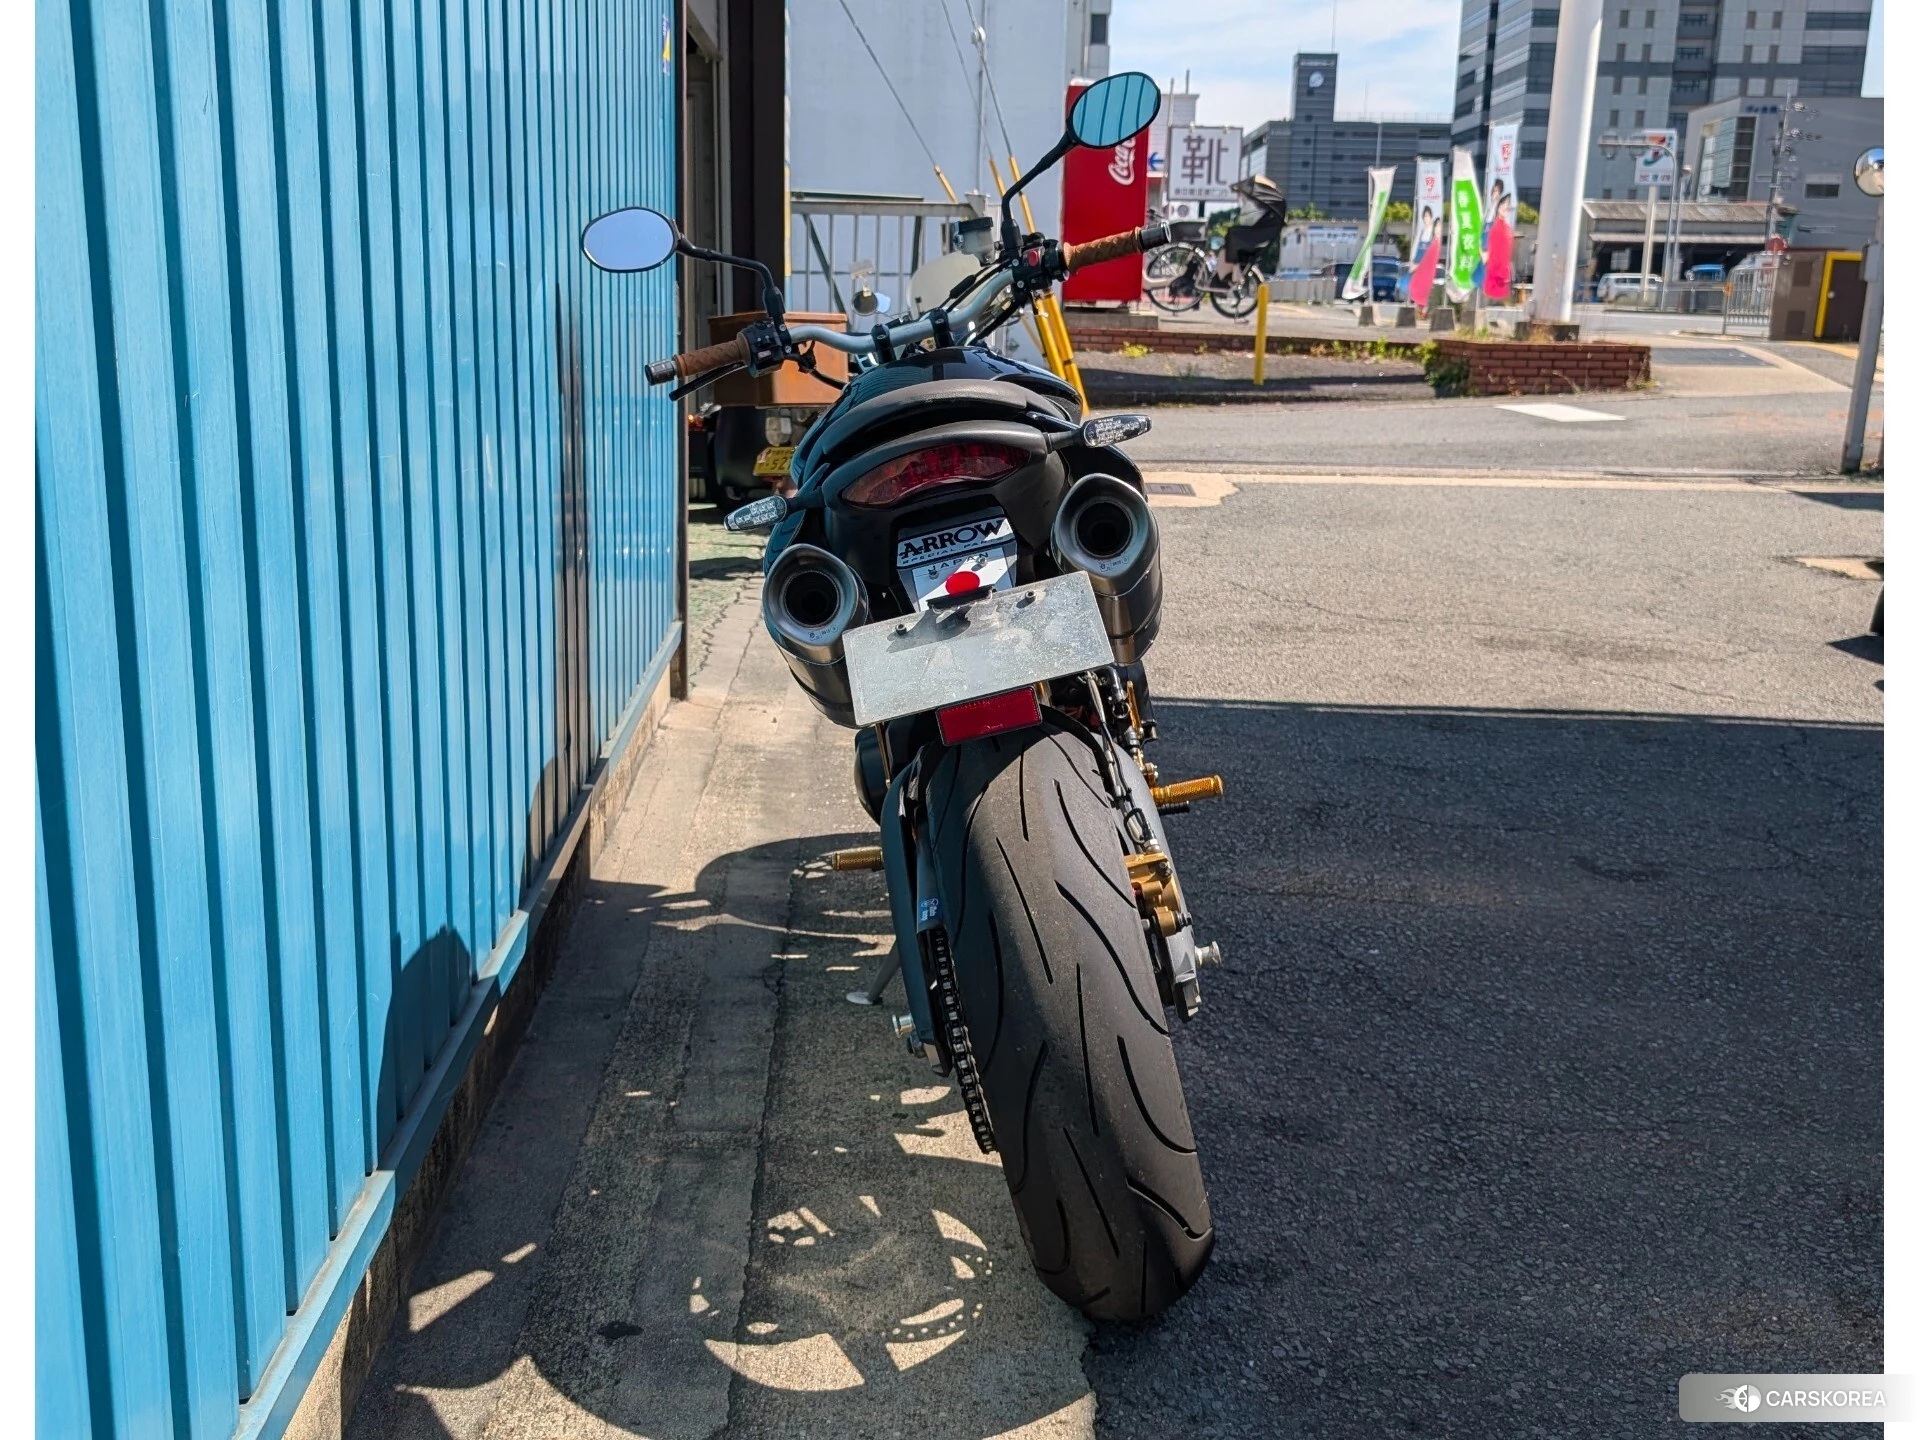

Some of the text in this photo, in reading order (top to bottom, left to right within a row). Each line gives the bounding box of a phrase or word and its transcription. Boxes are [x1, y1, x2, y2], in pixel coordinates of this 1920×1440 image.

[1181, 135, 1229, 185] 靴
[899, 519, 1004, 560] ARROW
[902, 548, 957, 565] SPECIAL
[928, 552, 989, 573] JAPAN
